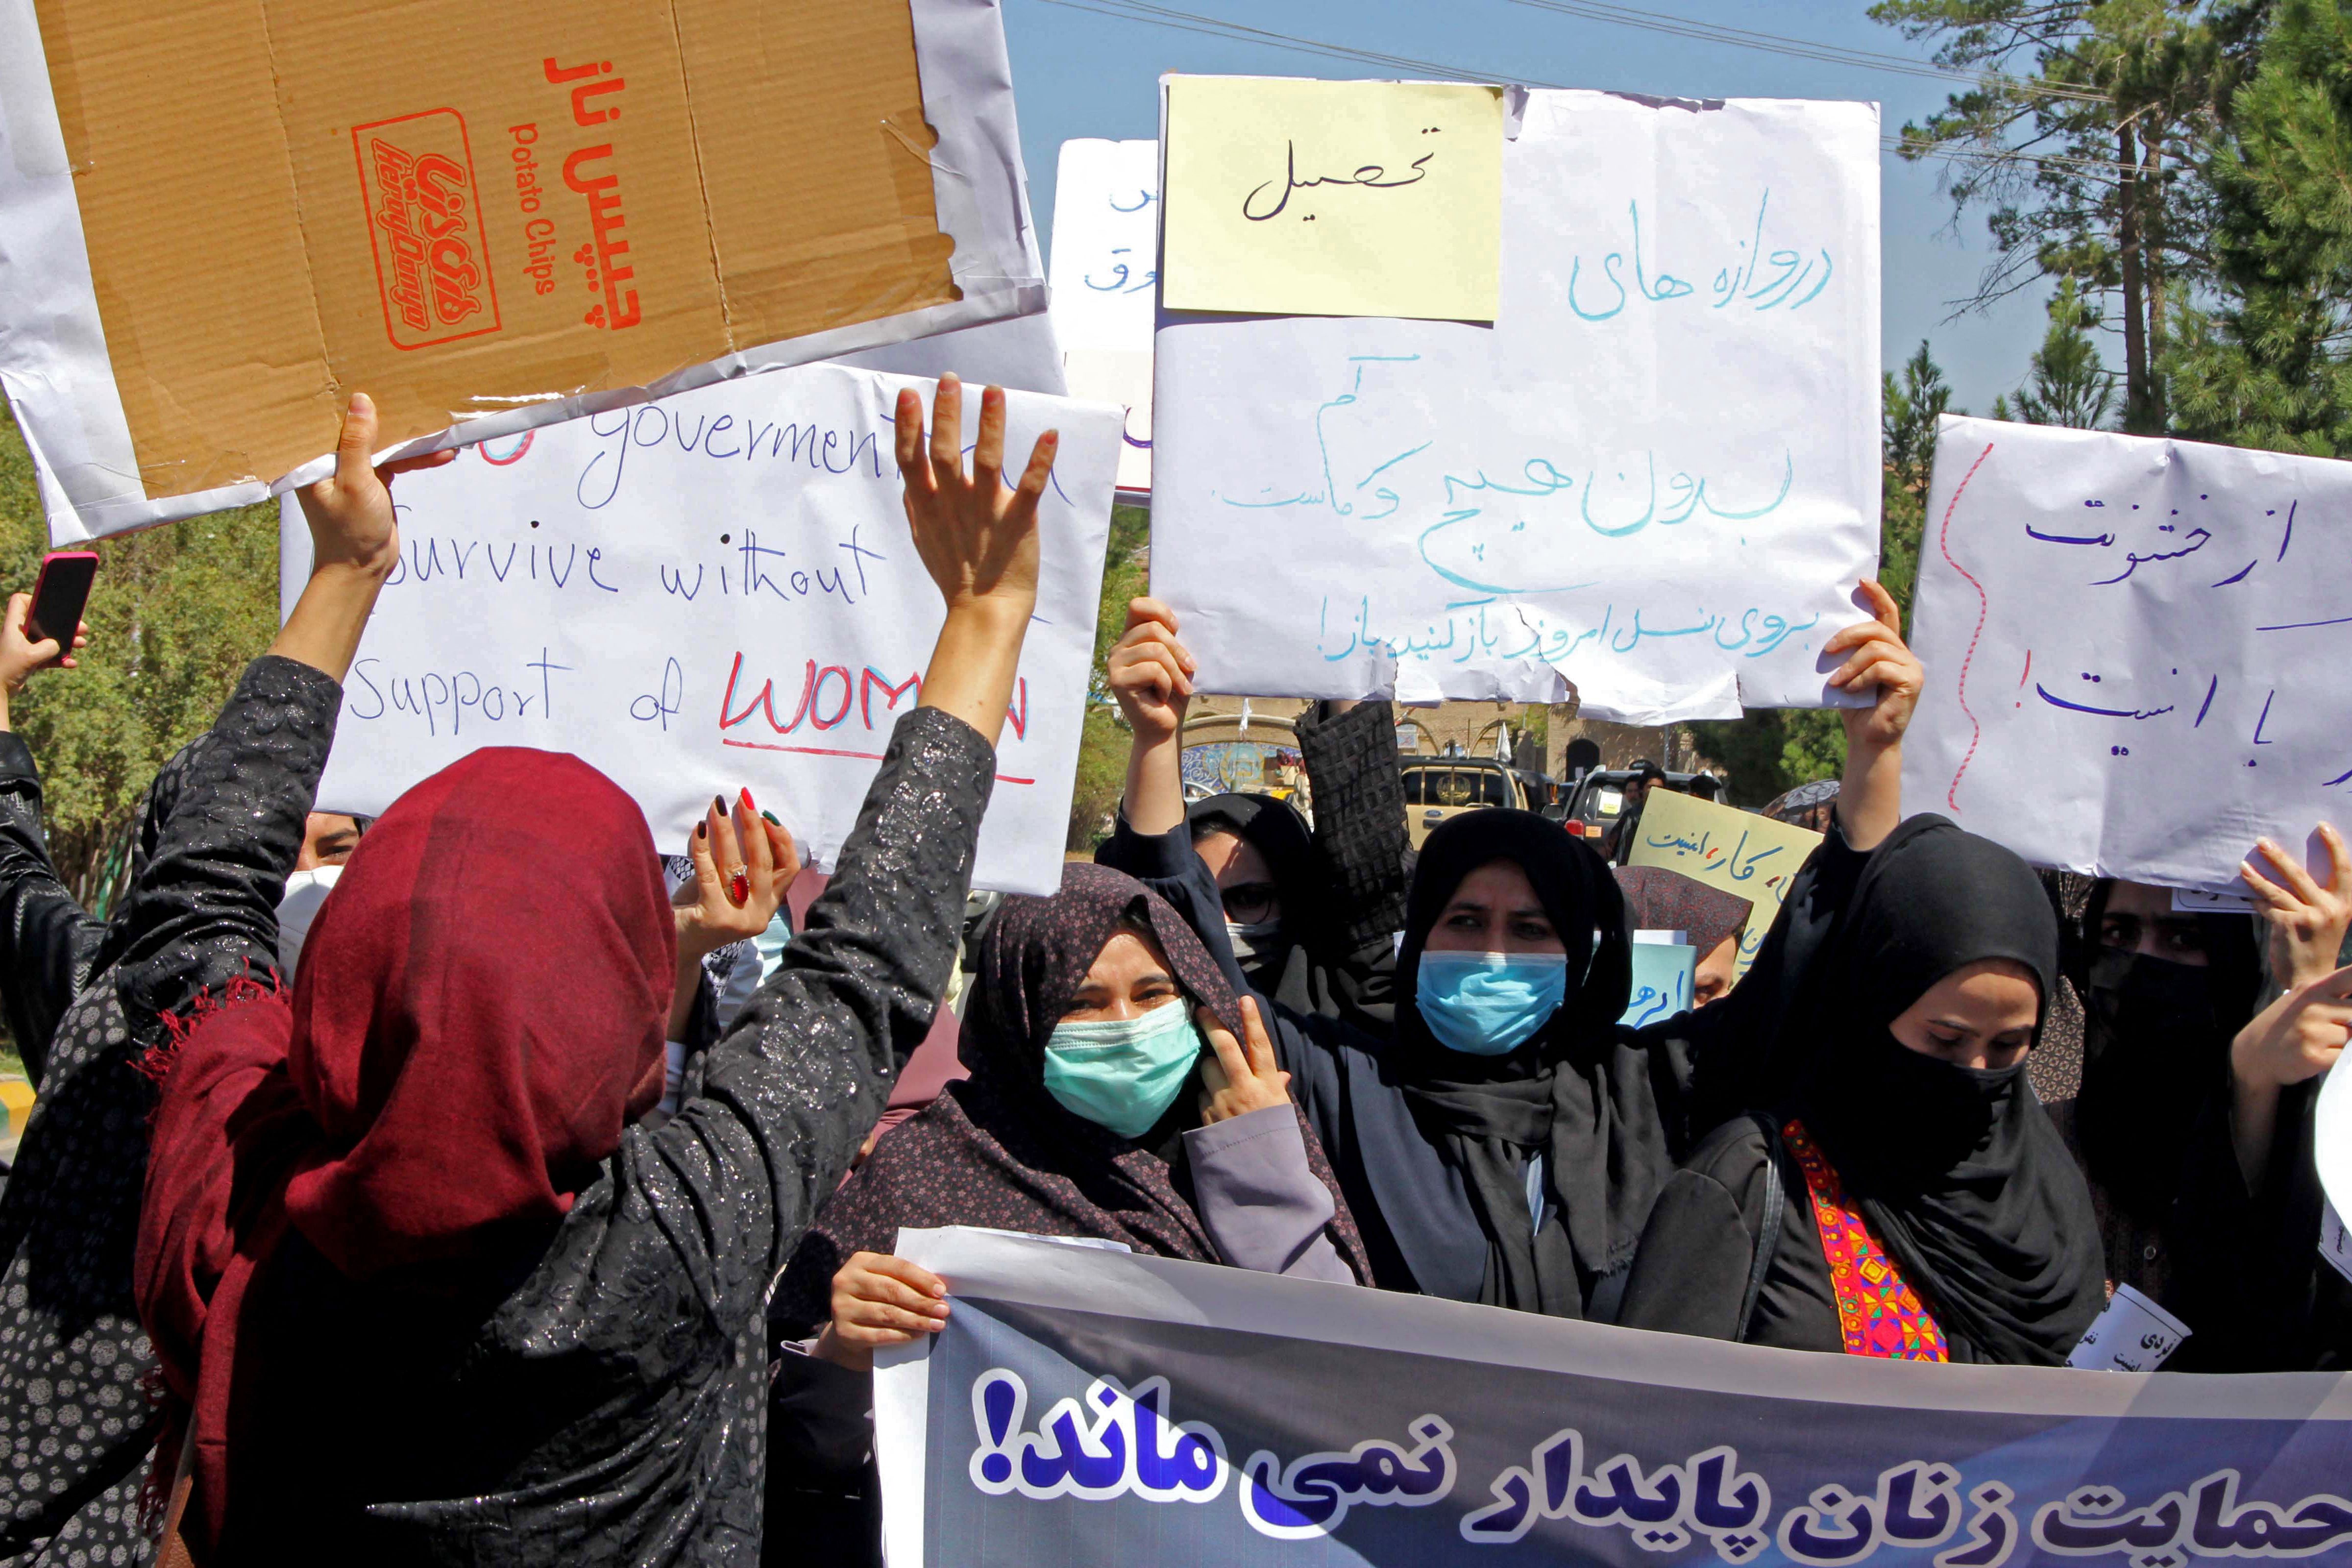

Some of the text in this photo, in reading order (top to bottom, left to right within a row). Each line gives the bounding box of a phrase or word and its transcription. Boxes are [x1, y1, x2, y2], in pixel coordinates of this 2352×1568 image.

[508, 122, 556, 296] Potato Chips
[542, 57, 640, 331] چیپس ناز
[1243, 126, 1441, 221] تحصیل
[1568, 187, 1833, 321] دروازه های
[1418, 458, 1601, 594] هیچ
[1582, 447, 1792, 545] بدون
[2025, 494, 2297, 588] از خشونت
[662, 524, 887, 605] without
[1502, 603, 1612, 662] امروز
[1613, 607, 1715, 653] نسل
[349, 647, 1029, 741] Support of WOMN
[973, 1371, 2352, 1568] حمایت زنان پایدار نمی ماند!
